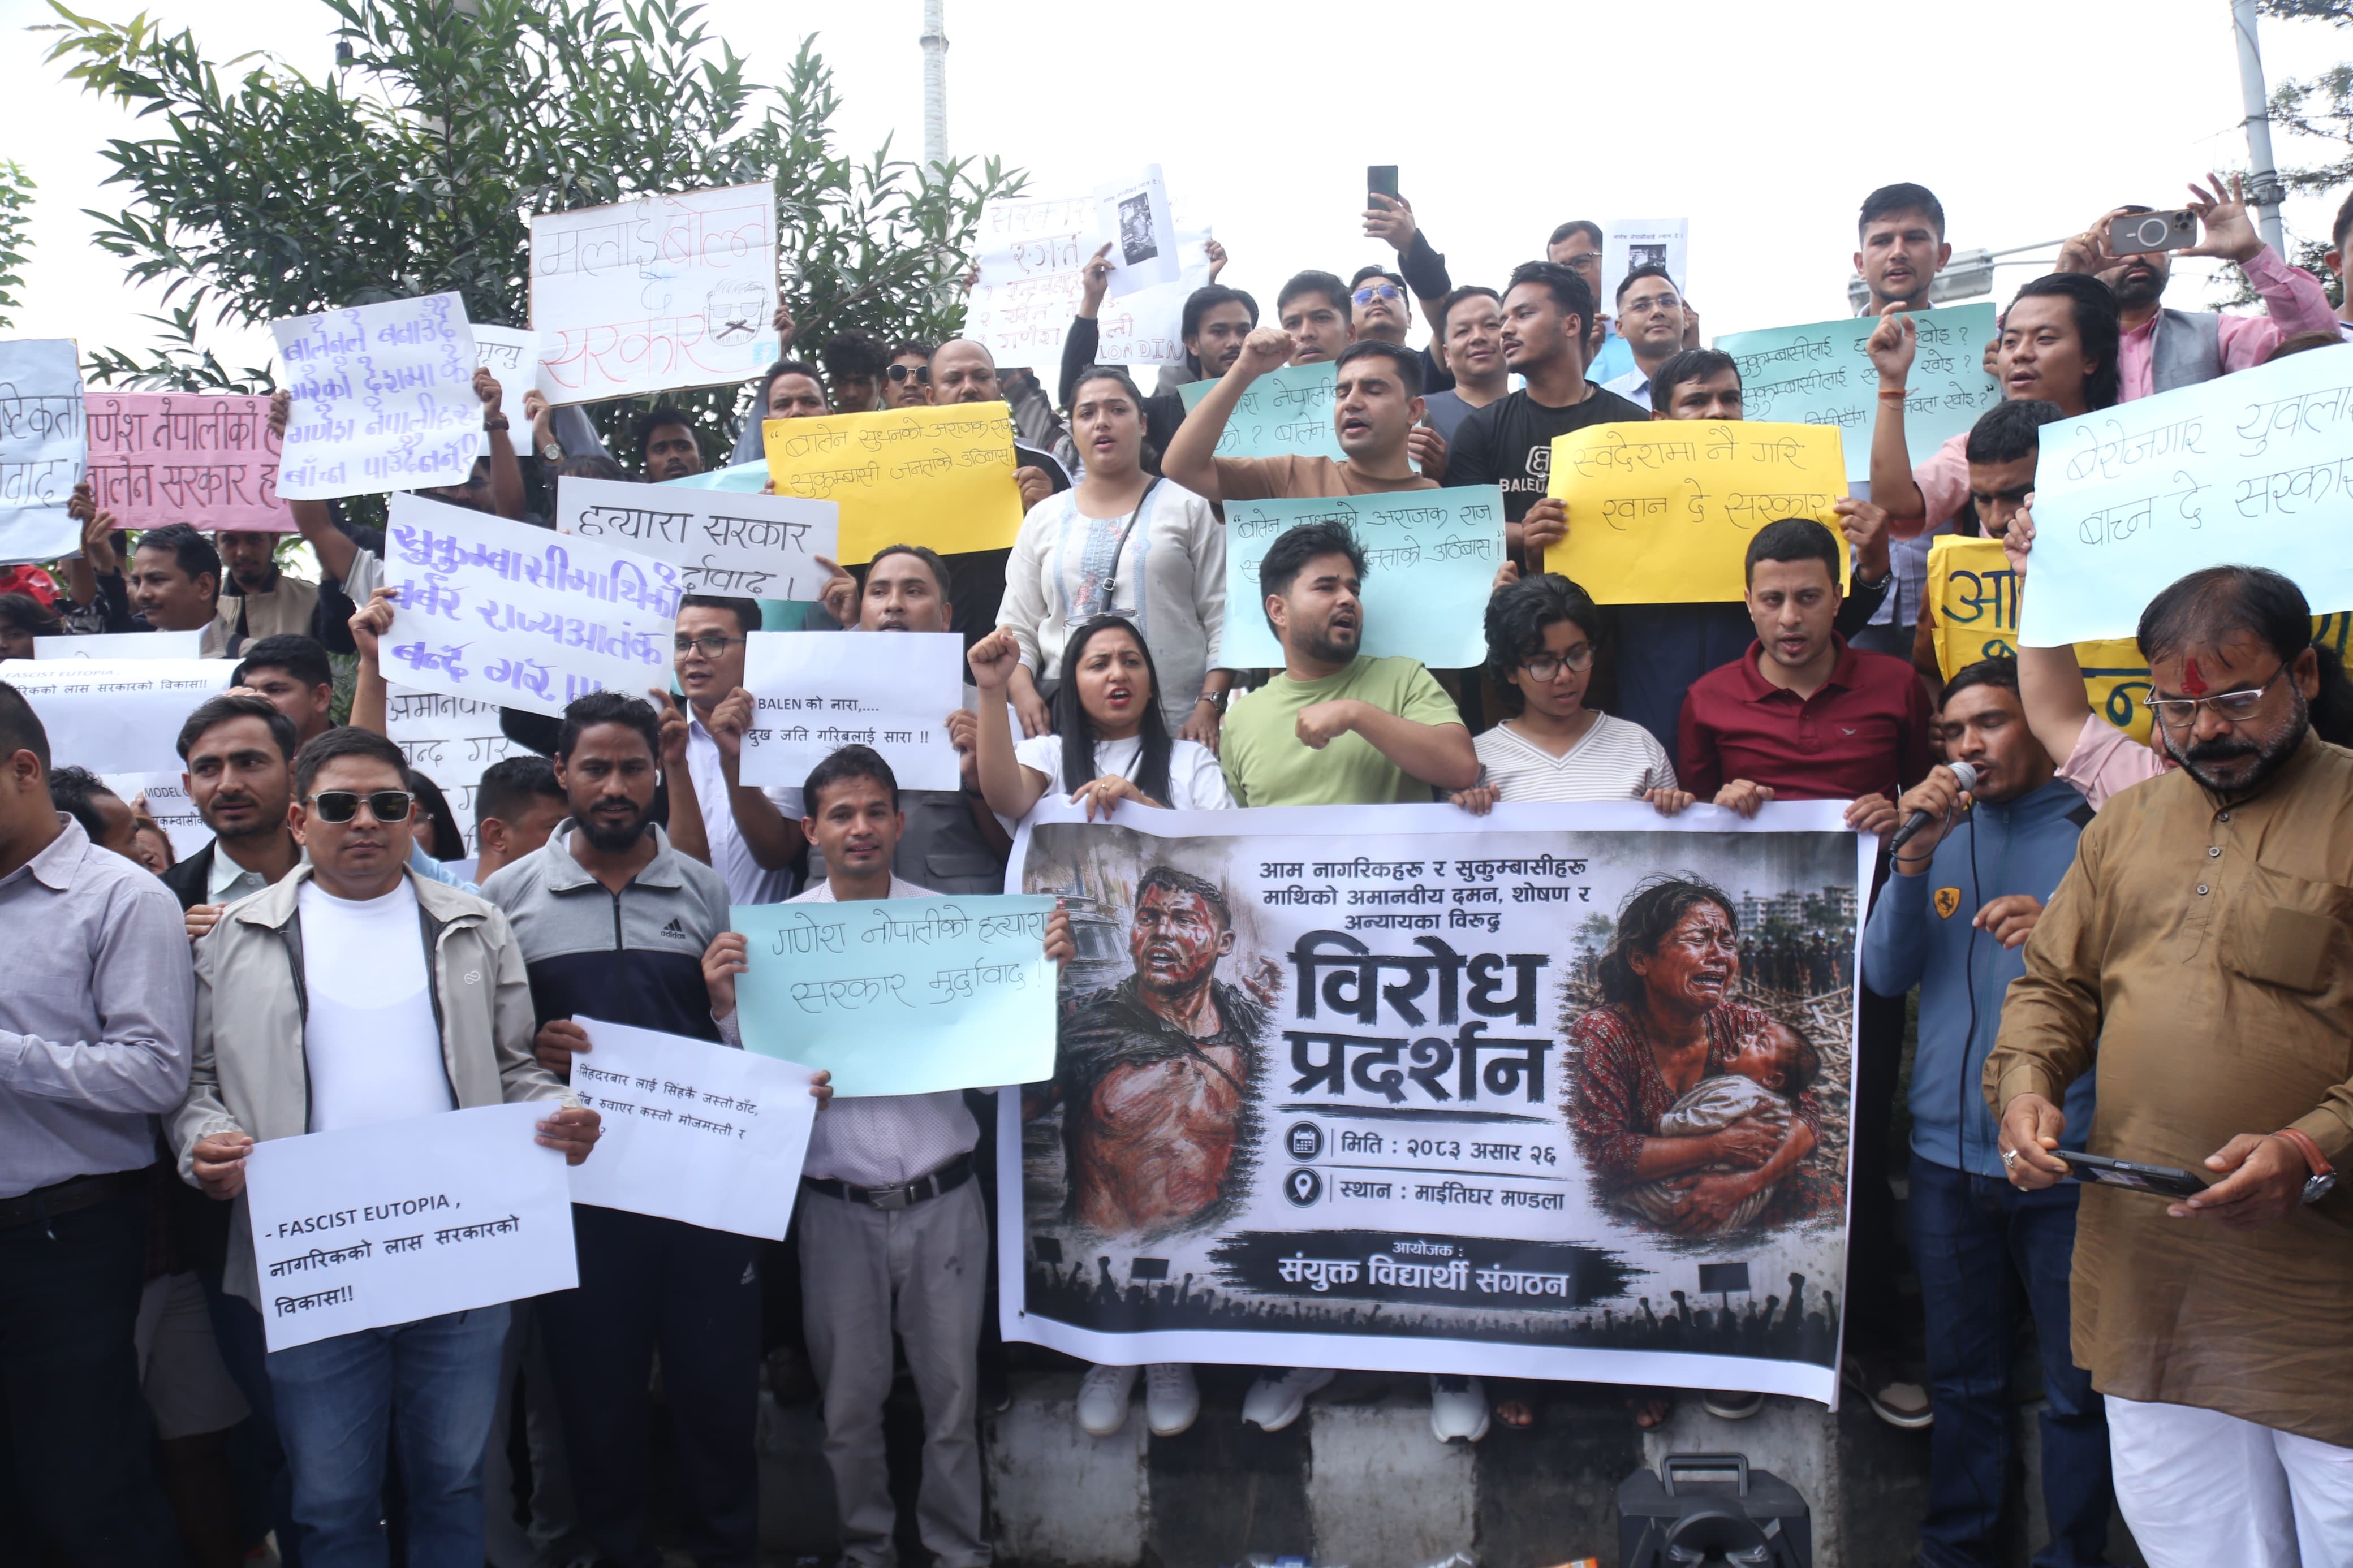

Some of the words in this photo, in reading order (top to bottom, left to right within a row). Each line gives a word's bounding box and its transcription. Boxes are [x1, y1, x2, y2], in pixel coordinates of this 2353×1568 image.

[758, 698, 801, 710] BALEN
[805, 696, 824, 711] को
[779, 725, 809, 742] जति
[816, 727, 876, 745] गरिबलाई
[884, 731, 913, 744] सारा
[144, 787, 182, 798] MODEL
[1259, 861, 1303, 879] आम
[1433, 861, 1447, 878] र
[1262, 885, 1338, 906] माथिको
[1347, 884, 1445, 905] अमानवीय
[1511, 883, 1569, 902] शोषण
[1578, 887, 1591, 902] र
[661, 930, 687, 940] adidas
[1344, 914, 1441, 930] अन्यायका
[790, 974, 917, 1013] सरकार
[1286, 929, 1552, 1028] विरोध
[1282, 1021, 1555, 1105] प्रदर्शन
[635, 1078, 658, 1093] लाई
[703, 1092, 734, 1109] जस्तो
[640, 1105, 673, 1122] कस्तो
[678, 1114, 733, 1137] मोजमस्ती
[738, 1129, 746, 1140] र
[1341, 1131, 1384, 1154] मिति
[1407, 1138, 1460, 1160] २०८३
[1471, 1142, 1523, 1161] असार
[1530, 1146, 1557, 1167] २६
[1340, 1181, 1393, 1200] स्थान
[1501, 1189, 1565, 1210] मण्डला
[278, 1208, 358, 1239] FASCIST
[363, 1193, 450, 1222] EUTOPIA
[268, 1239, 372, 1278] नागरिकको
[382, 1234, 424, 1255] लास
[434, 1214, 520, 1246] सरकारको
[1392, 1240, 1454, 1258] आयोजक
[1278, 1252, 1361, 1293] संयुक्त
[1368, 1254, 1469, 1292] विद्यार्थी
[1475, 1263, 1570, 1298] संगठन
